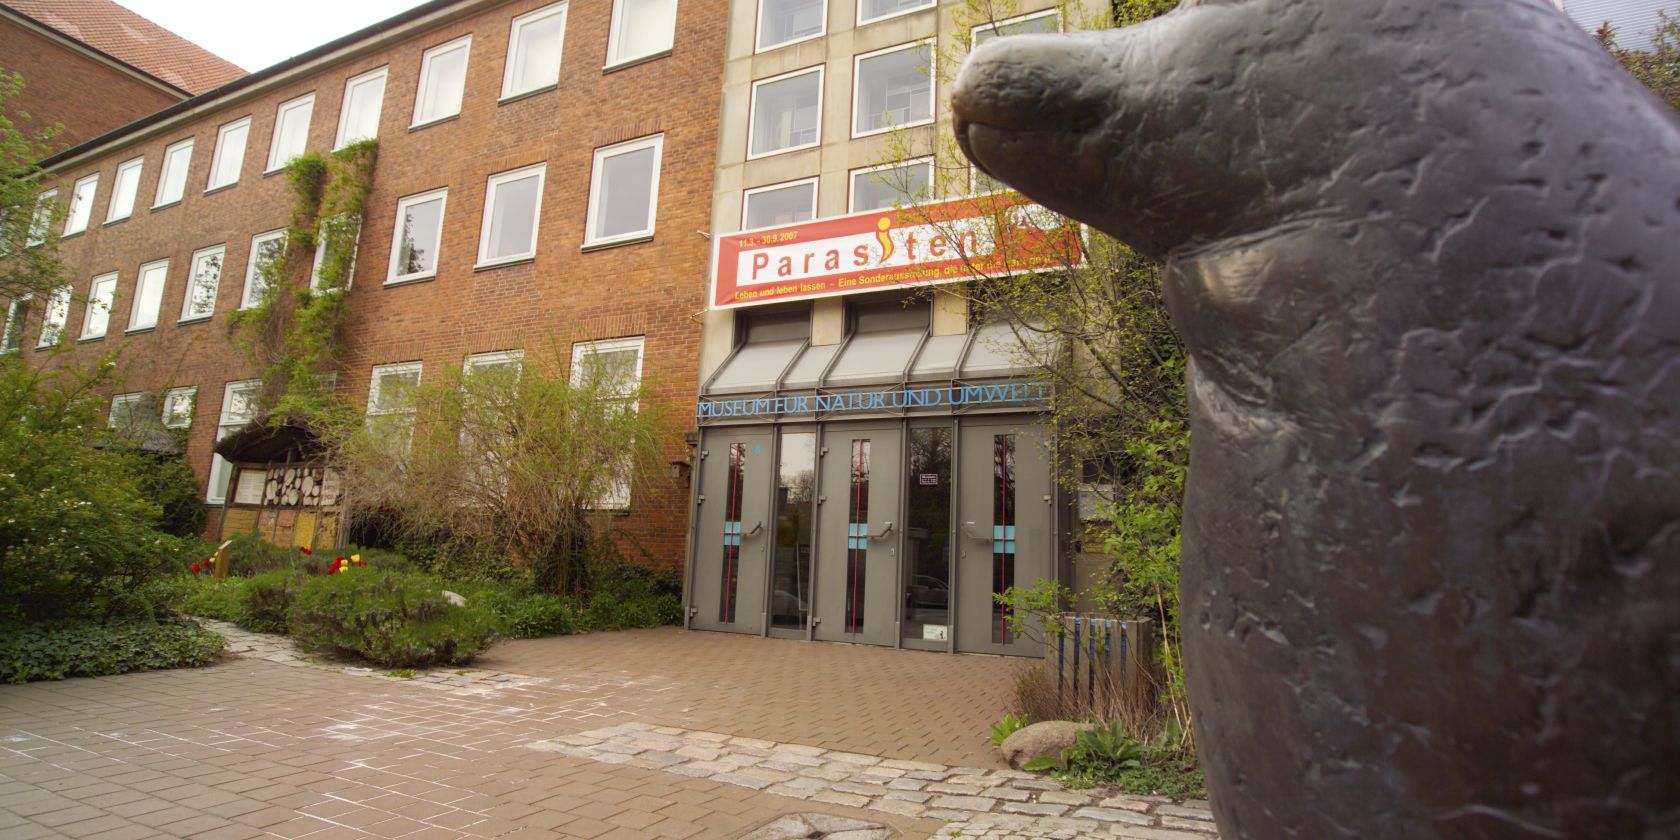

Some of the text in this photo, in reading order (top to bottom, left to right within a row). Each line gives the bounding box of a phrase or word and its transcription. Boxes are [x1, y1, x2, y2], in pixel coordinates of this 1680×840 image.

[752, 217, 977, 280] Parasiten
[735, 290, 758, 300] Leben
[760, 287, 774, 296] und
[776, 284, 797, 295] leben
[800, 281, 825, 292] lassen
[838, 278, 856, 288] Eine
[697, 400, 769, 417] MUSEUM
[815, 391, 887, 412] NATUR
[892, 388, 941, 408] UND
[948, 381, 1048, 405] UMWELT
